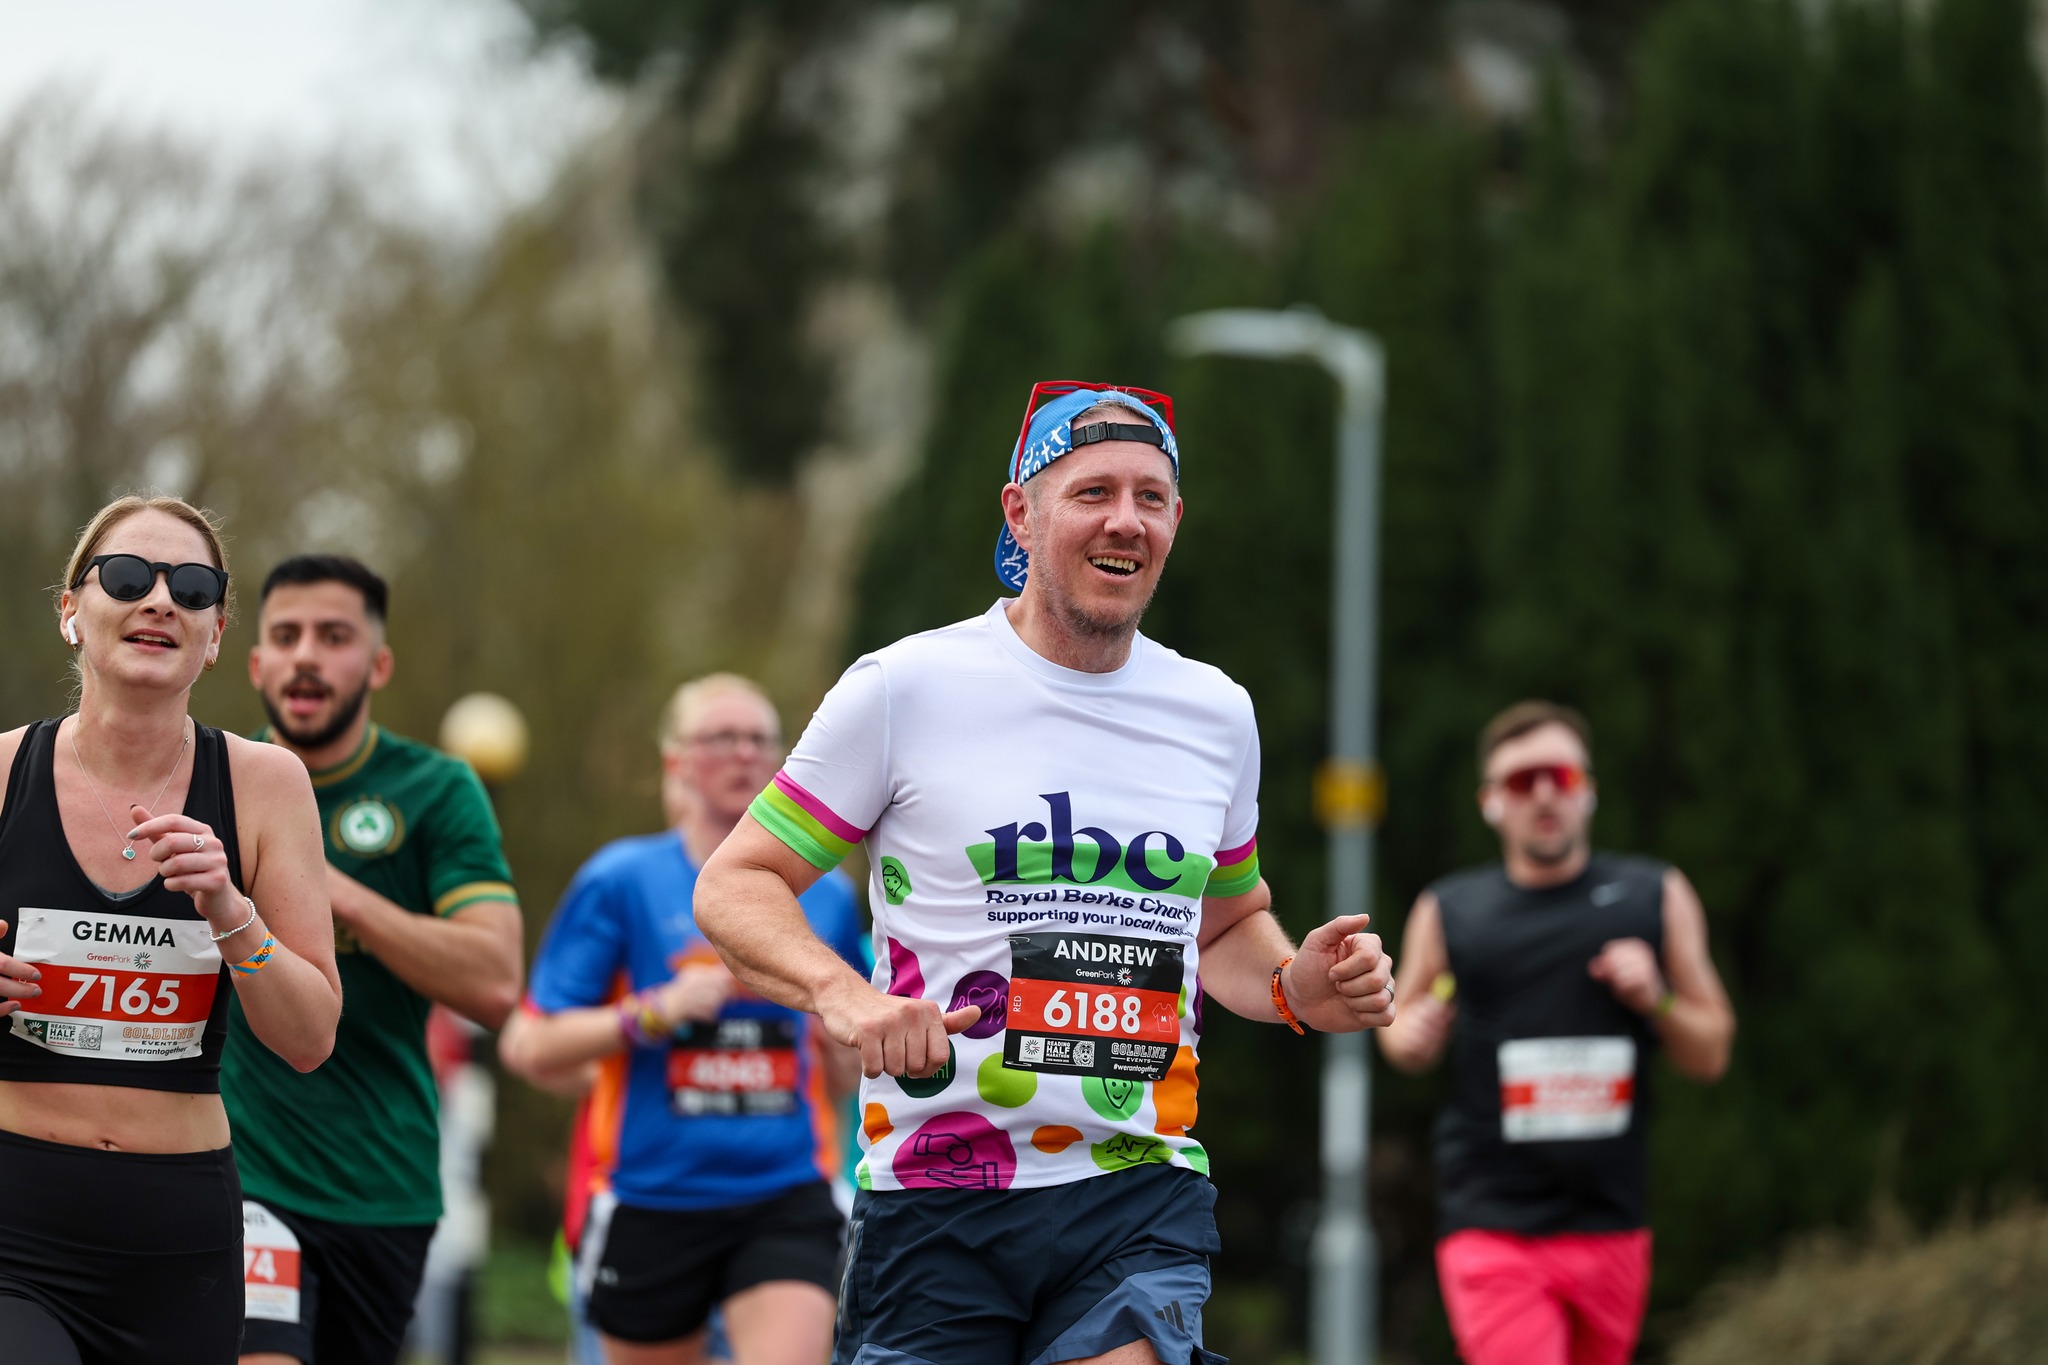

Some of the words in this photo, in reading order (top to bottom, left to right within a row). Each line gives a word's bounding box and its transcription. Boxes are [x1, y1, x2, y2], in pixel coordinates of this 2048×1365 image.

[985, 791, 1185, 891] rbc
[985, 889, 1057, 906] Royal
[1062, 889, 1135, 910] Berks
[987, 910, 1079, 924] supporting
[1083, 913, 1117, 926] your
[1120, 913, 1155, 931] local
[72, 920, 176, 948] GEMMA
[86, 952, 131, 965] GreenPark
[1053, 939, 1158, 967] ANDREW
[1075, 968, 1115, 980] GreenPark
[65, 973, 181, 1016] 7165
[1012, 995, 1021, 1013] RED
[1043, 989, 1142, 1035] 6188
[50, 1028, 76, 1038] HALF
[122, 1027, 196, 1040] GOLDLINE
[125, 1046, 188, 1056] #werantogether
[1046, 1045, 1070, 1055] HALF
[1111, 1042, 1167, 1060] GOLDLINE
[1113, 1063, 1160, 1074] #werantogether
